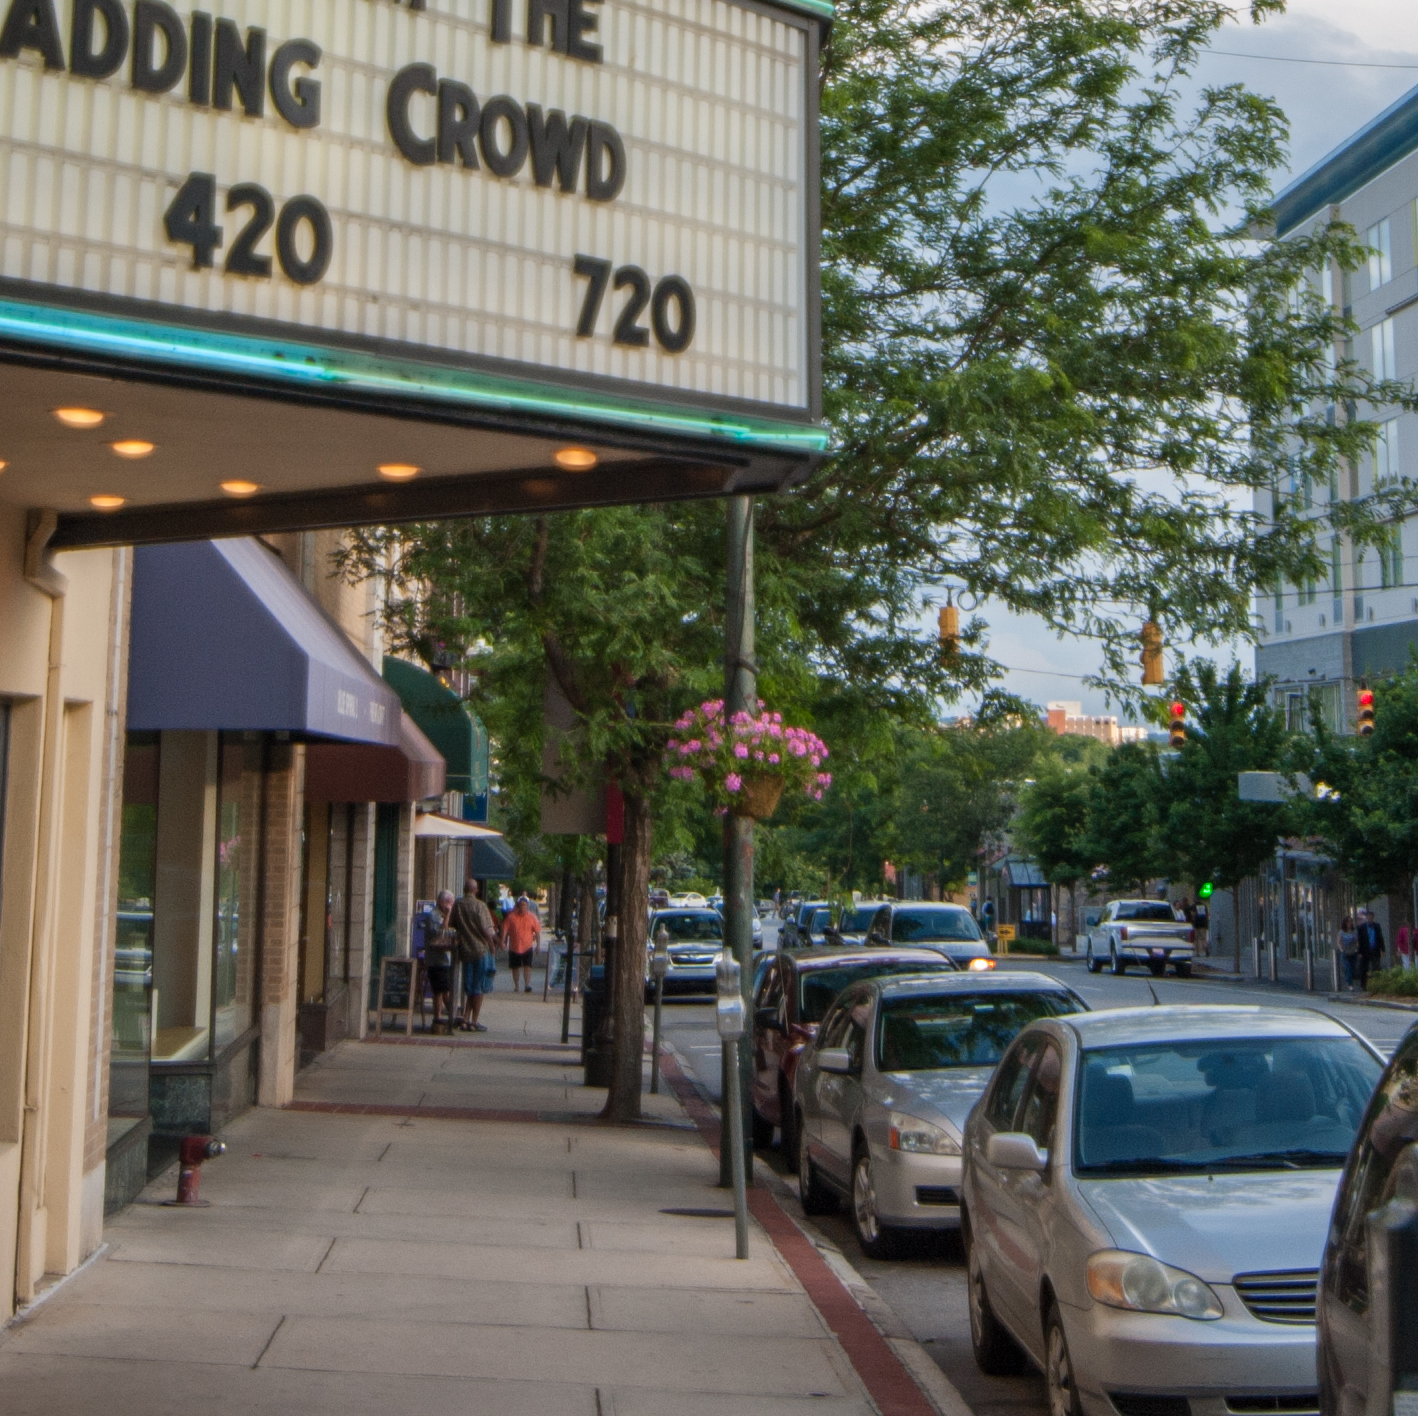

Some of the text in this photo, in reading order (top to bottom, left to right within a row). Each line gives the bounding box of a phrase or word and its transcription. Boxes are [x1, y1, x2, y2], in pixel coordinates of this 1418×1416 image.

[386, 62, 627, 204] CROWD
[164, 172, 335, 286] 420
[572, 254, 696, 353] 720
